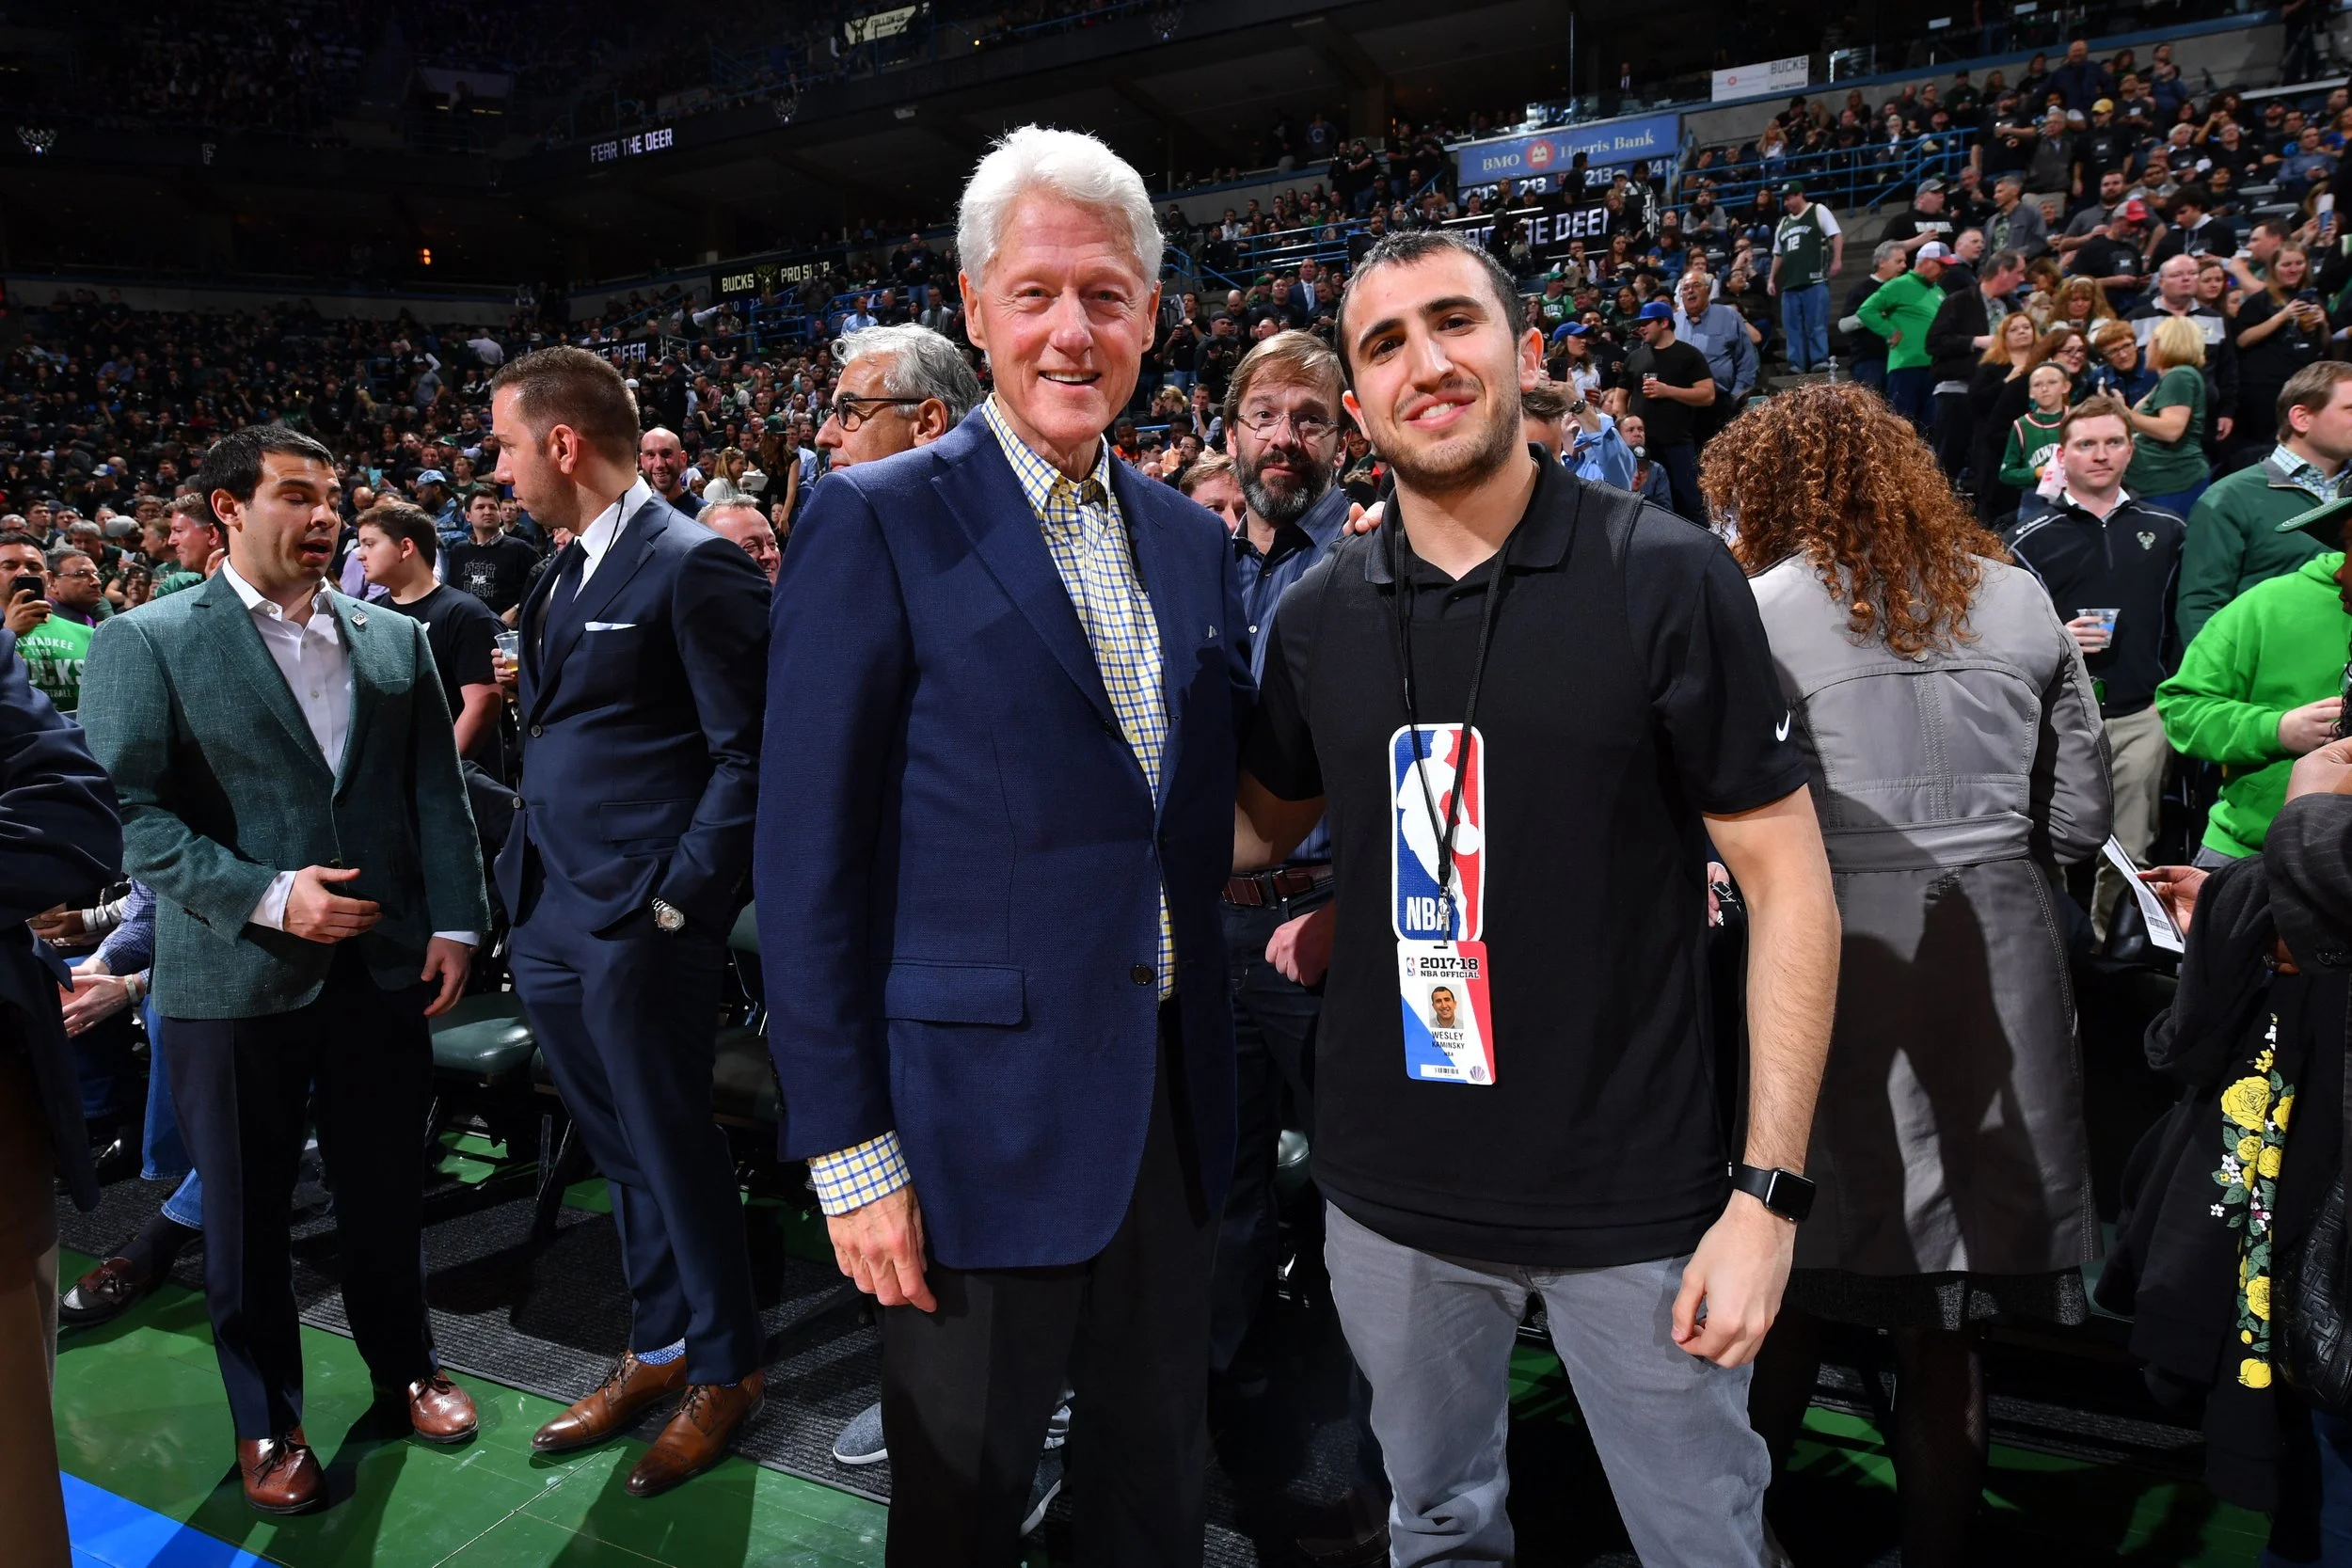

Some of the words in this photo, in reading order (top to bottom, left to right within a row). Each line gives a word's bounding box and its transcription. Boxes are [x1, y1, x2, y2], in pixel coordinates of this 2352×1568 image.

[1771, 57, 1807, 75] BUCKS
[591, 141, 618, 164] FEAR
[621, 135, 643, 156] THE
[645, 128, 674, 151] DEER
[1483, 154, 1520, 170] BMO
[1614, 131, 1654, 150] Bank
[1585, 167, 1613, 186] 213
[1788, 235, 1800, 252] 12
[722, 274, 755, 293] BUCKS
[781, 266, 801, 284] PRO
[463, 561, 496, 578] FEAR
[470, 575, 486, 584] THE
[23, 658, 86, 686] UCKS
[1406, 896, 1450, 931] NBA
[1420, 957, 1479, 970] 2017-18
[1432, 1031, 1464, 1040] WESLEY
[1432, 1041, 1465, 1050] KAMINSKY
